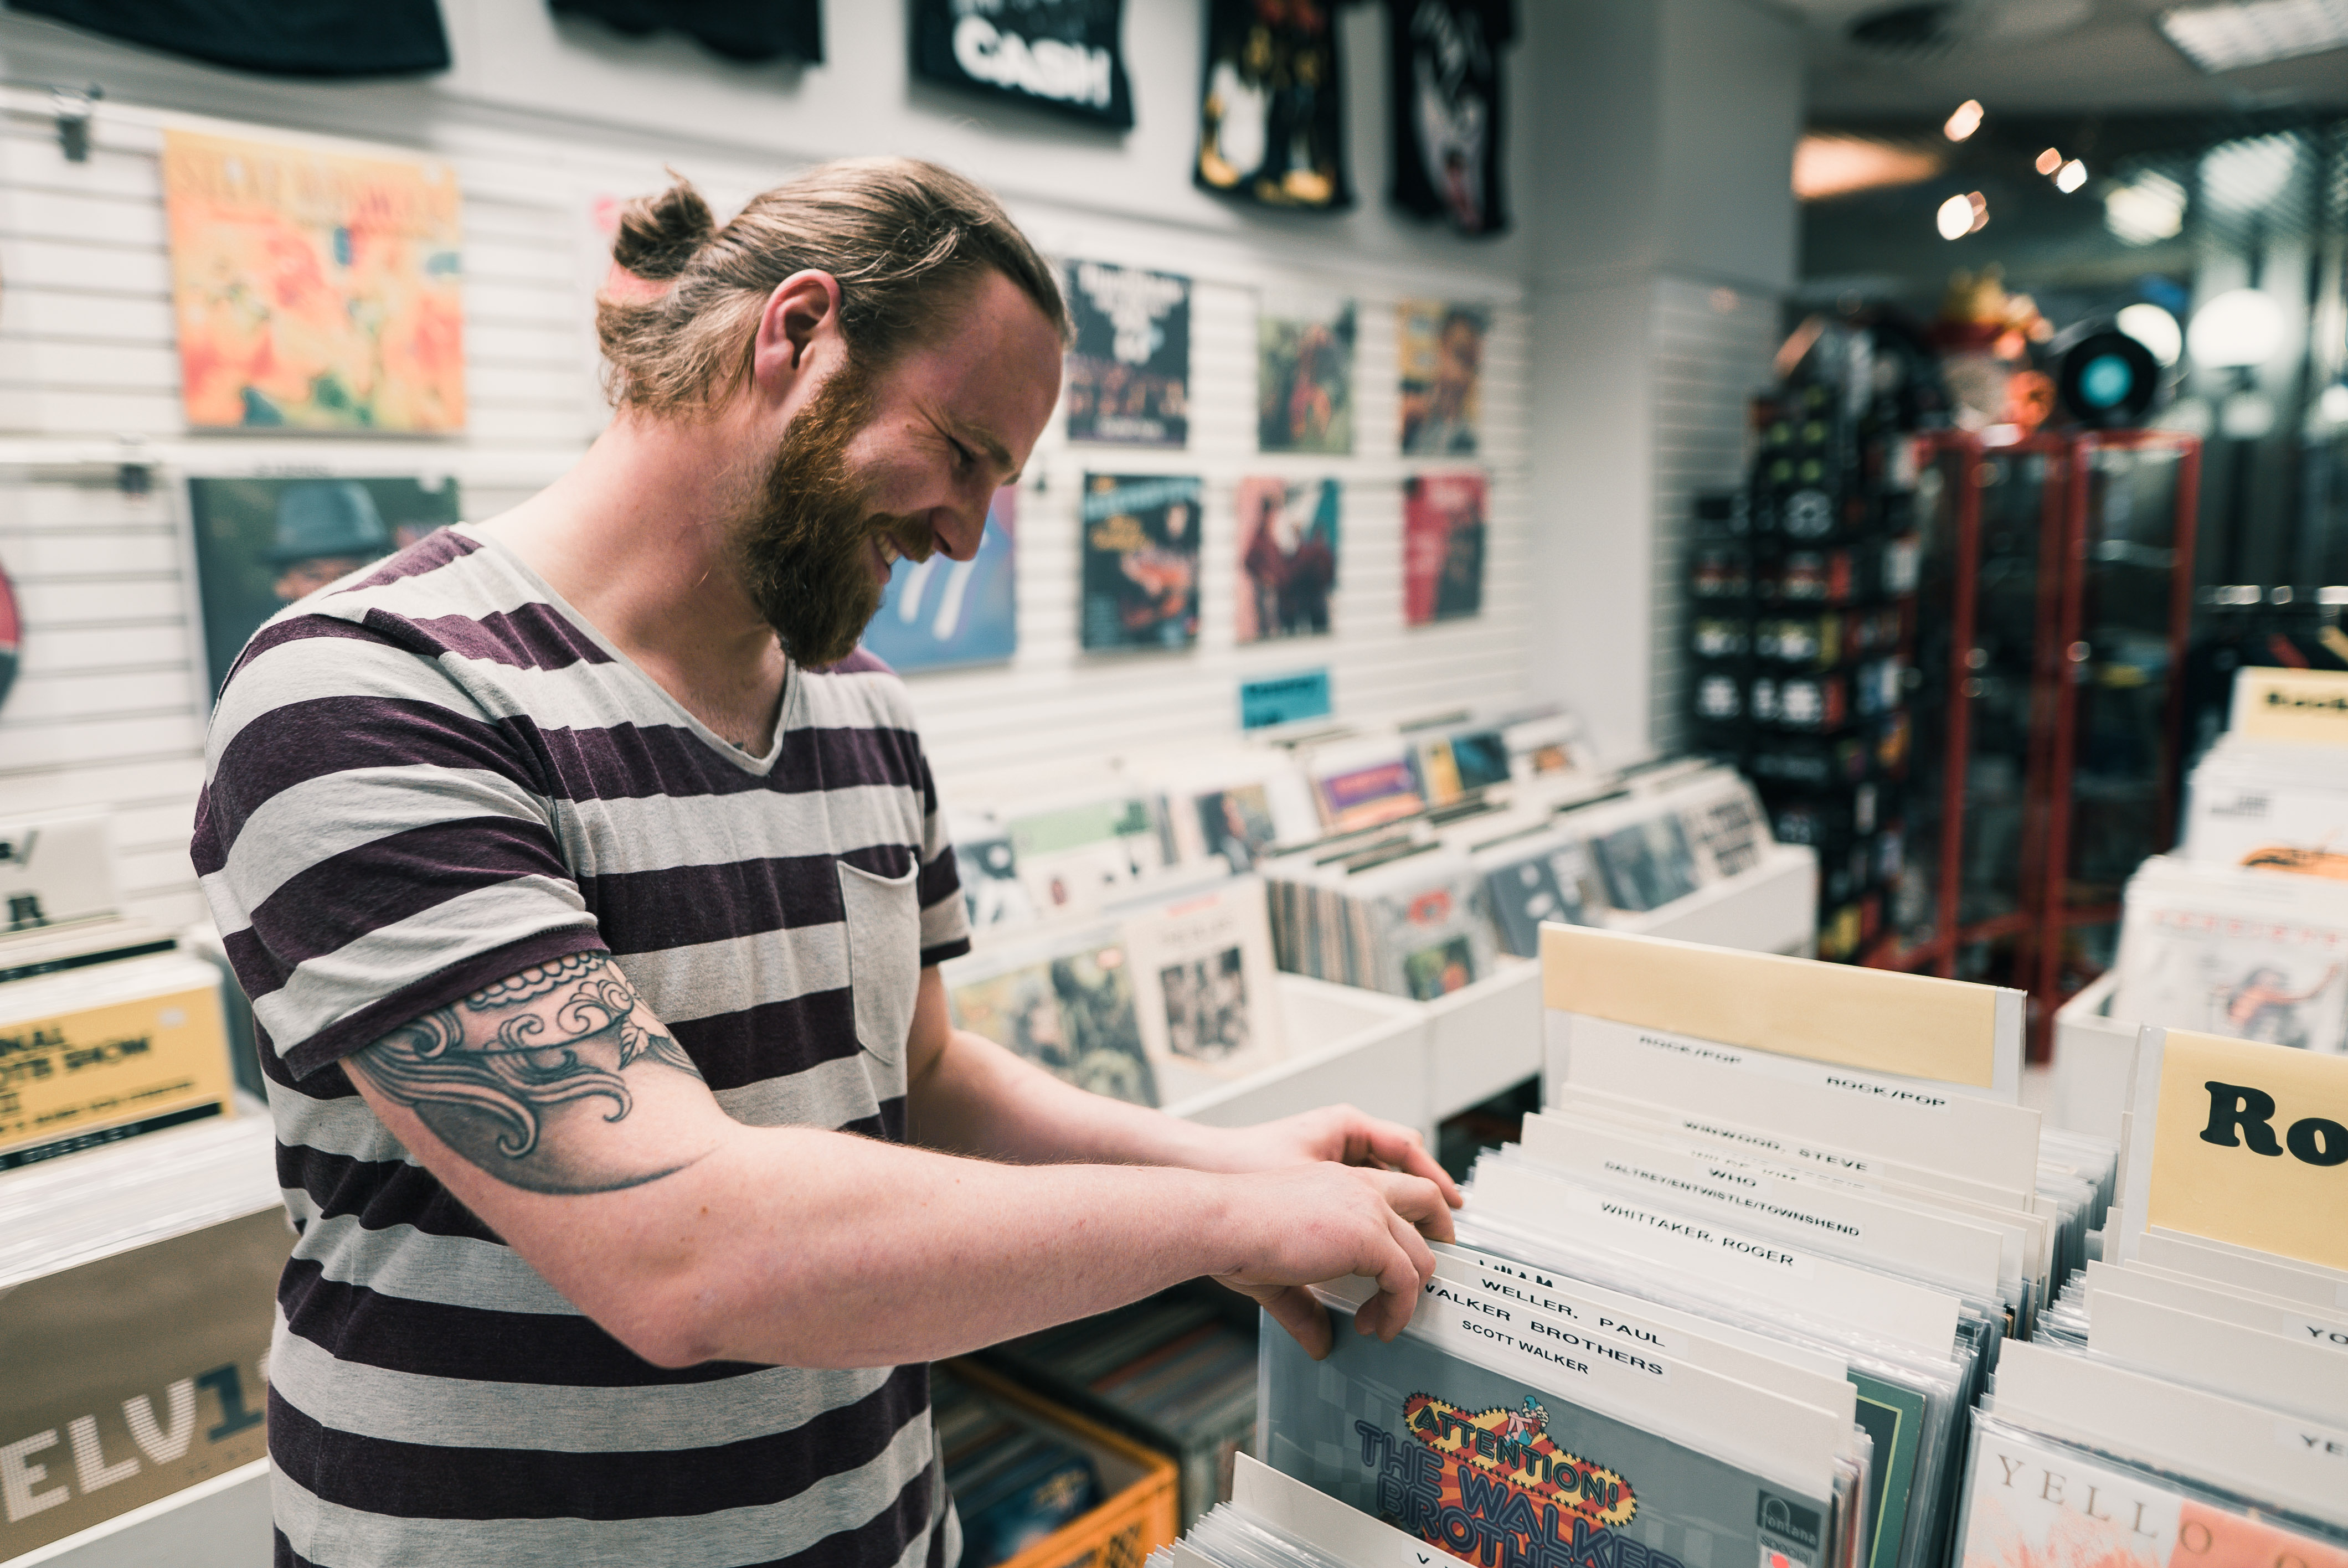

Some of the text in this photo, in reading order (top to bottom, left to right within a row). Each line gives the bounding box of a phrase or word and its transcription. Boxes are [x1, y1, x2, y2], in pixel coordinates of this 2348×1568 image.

[951, 13, 1113, 109] CASH
[1639, 1034, 1742, 1065] ROCK/POP
[1826, 1076, 1947, 1107] ROCK/POP
[1708, 1167, 1757, 1189] WHO
[1799, 1147, 1868, 1172] STEVE
[1601, 1200, 1794, 1267] WHITTAKER, ROGER
[1423, 1283, 1664, 1375] WALKER BROTHERS
[1462, 1319, 1589, 1375] SCOTT WALKER
[1481, 1277, 1666, 1348] WELLER, PAUL
[0, 1348, 270, 1524] ELV1
[1355, 1418, 1445, 1502] THE
[1413, 1405, 1620, 1513] ATTENTION!
[1760, 1496, 1817, 1546] fontana
[1998, 1453, 2213, 1555] YELLO
